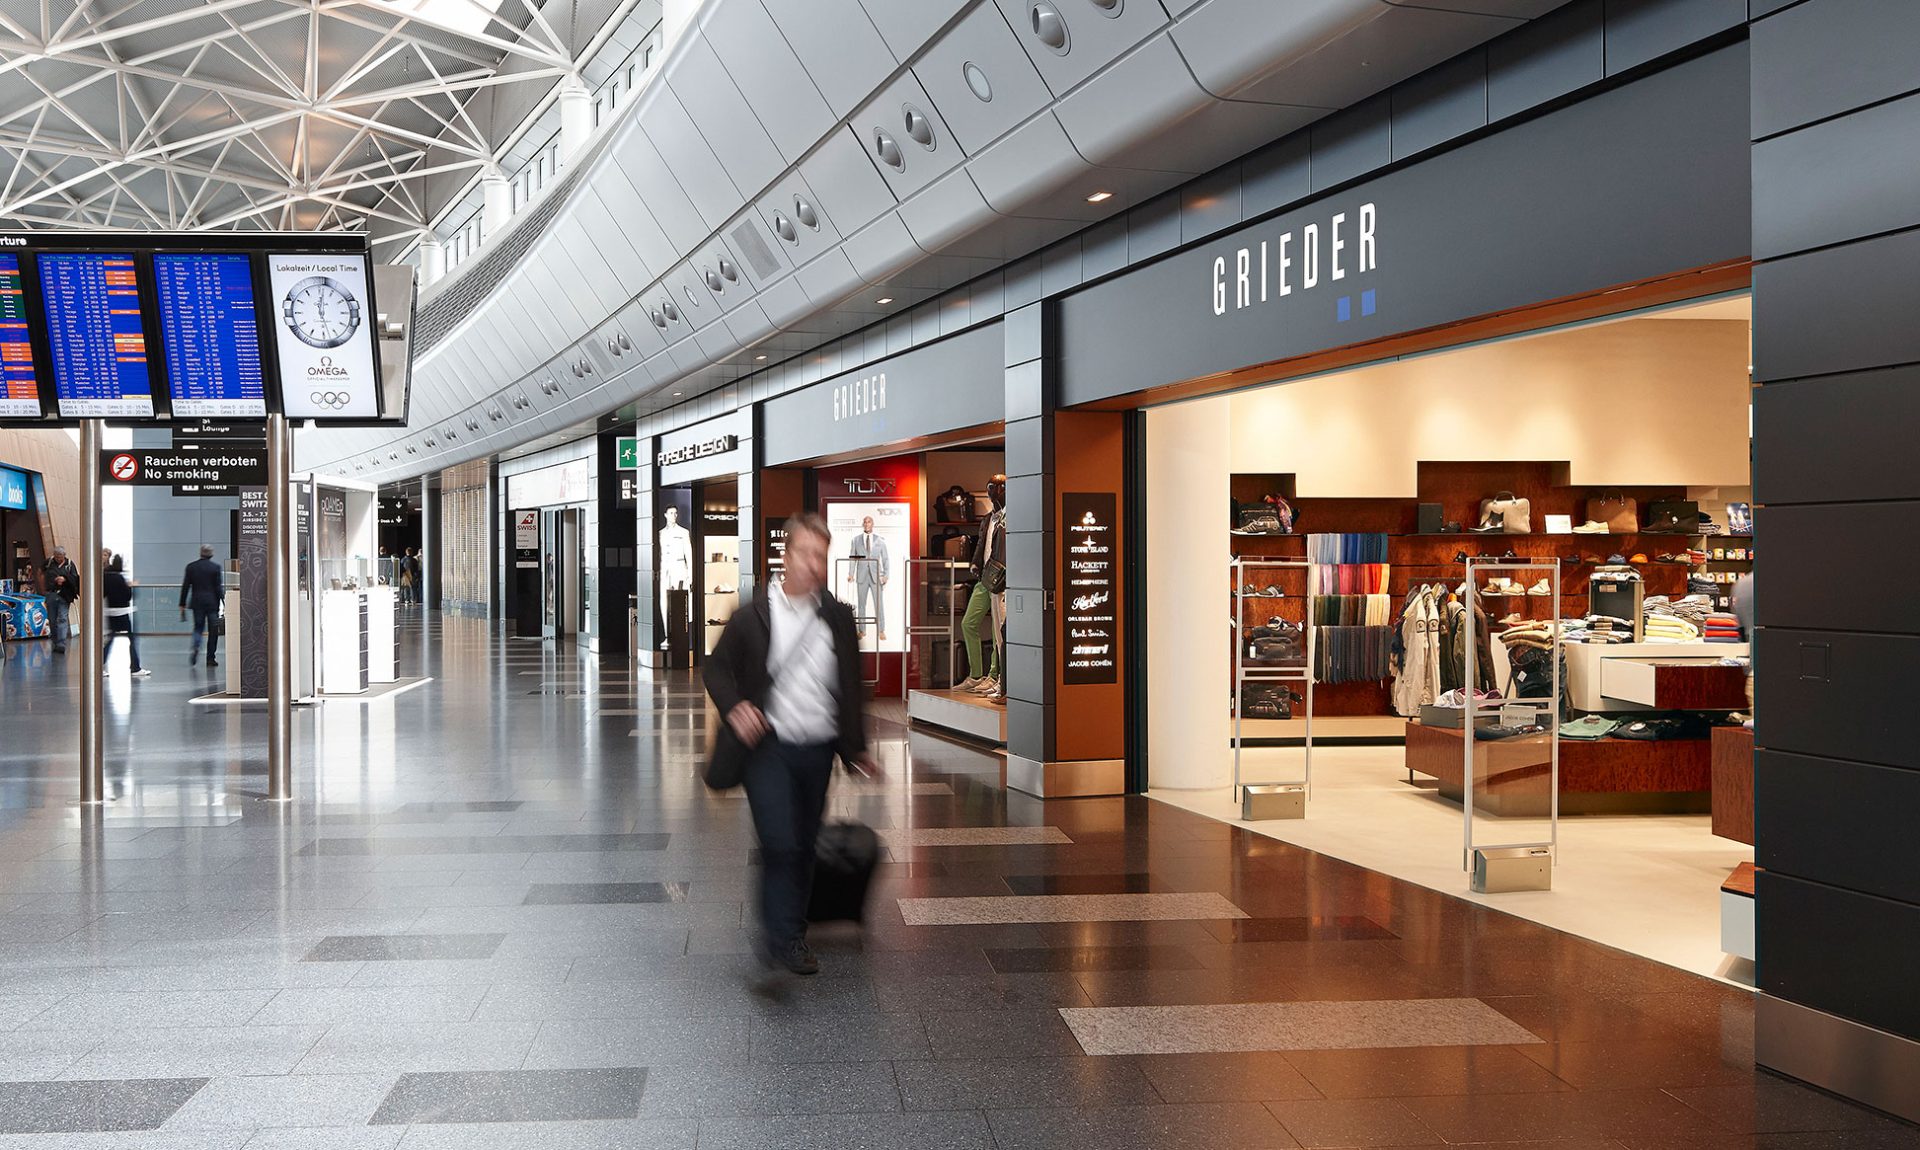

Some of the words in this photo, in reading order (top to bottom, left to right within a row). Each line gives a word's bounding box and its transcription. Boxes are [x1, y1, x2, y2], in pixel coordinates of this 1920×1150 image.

[1213, 202, 1377, 317] GRIEDER
[276, 264, 310, 272] Lokalzeit
[317, 264, 337, 272] Local
[340, 264, 358, 272] Time
[307, 366, 349, 376] OMEGA
[833, 373, 887, 422] GRIEDER
[657, 444, 695, 467] PORSCHE
[695, 434, 732, 460] DESIGN
[144, 455, 199, 467] Rauchen
[202, 455, 258, 467] verboten
[144, 469, 162, 479] No
[166, 468, 220, 481] smoking
[844, 478, 896, 494] TUMI
[8, 482, 23, 505] books
[242, 491, 264, 500] BEST
[1071, 560, 1109, 569] HACKETT
[1071, 628, 1088, 638] Paul
[1087, 628, 1110, 638] Smith
[1068, 660, 1090, 668] JACOB
